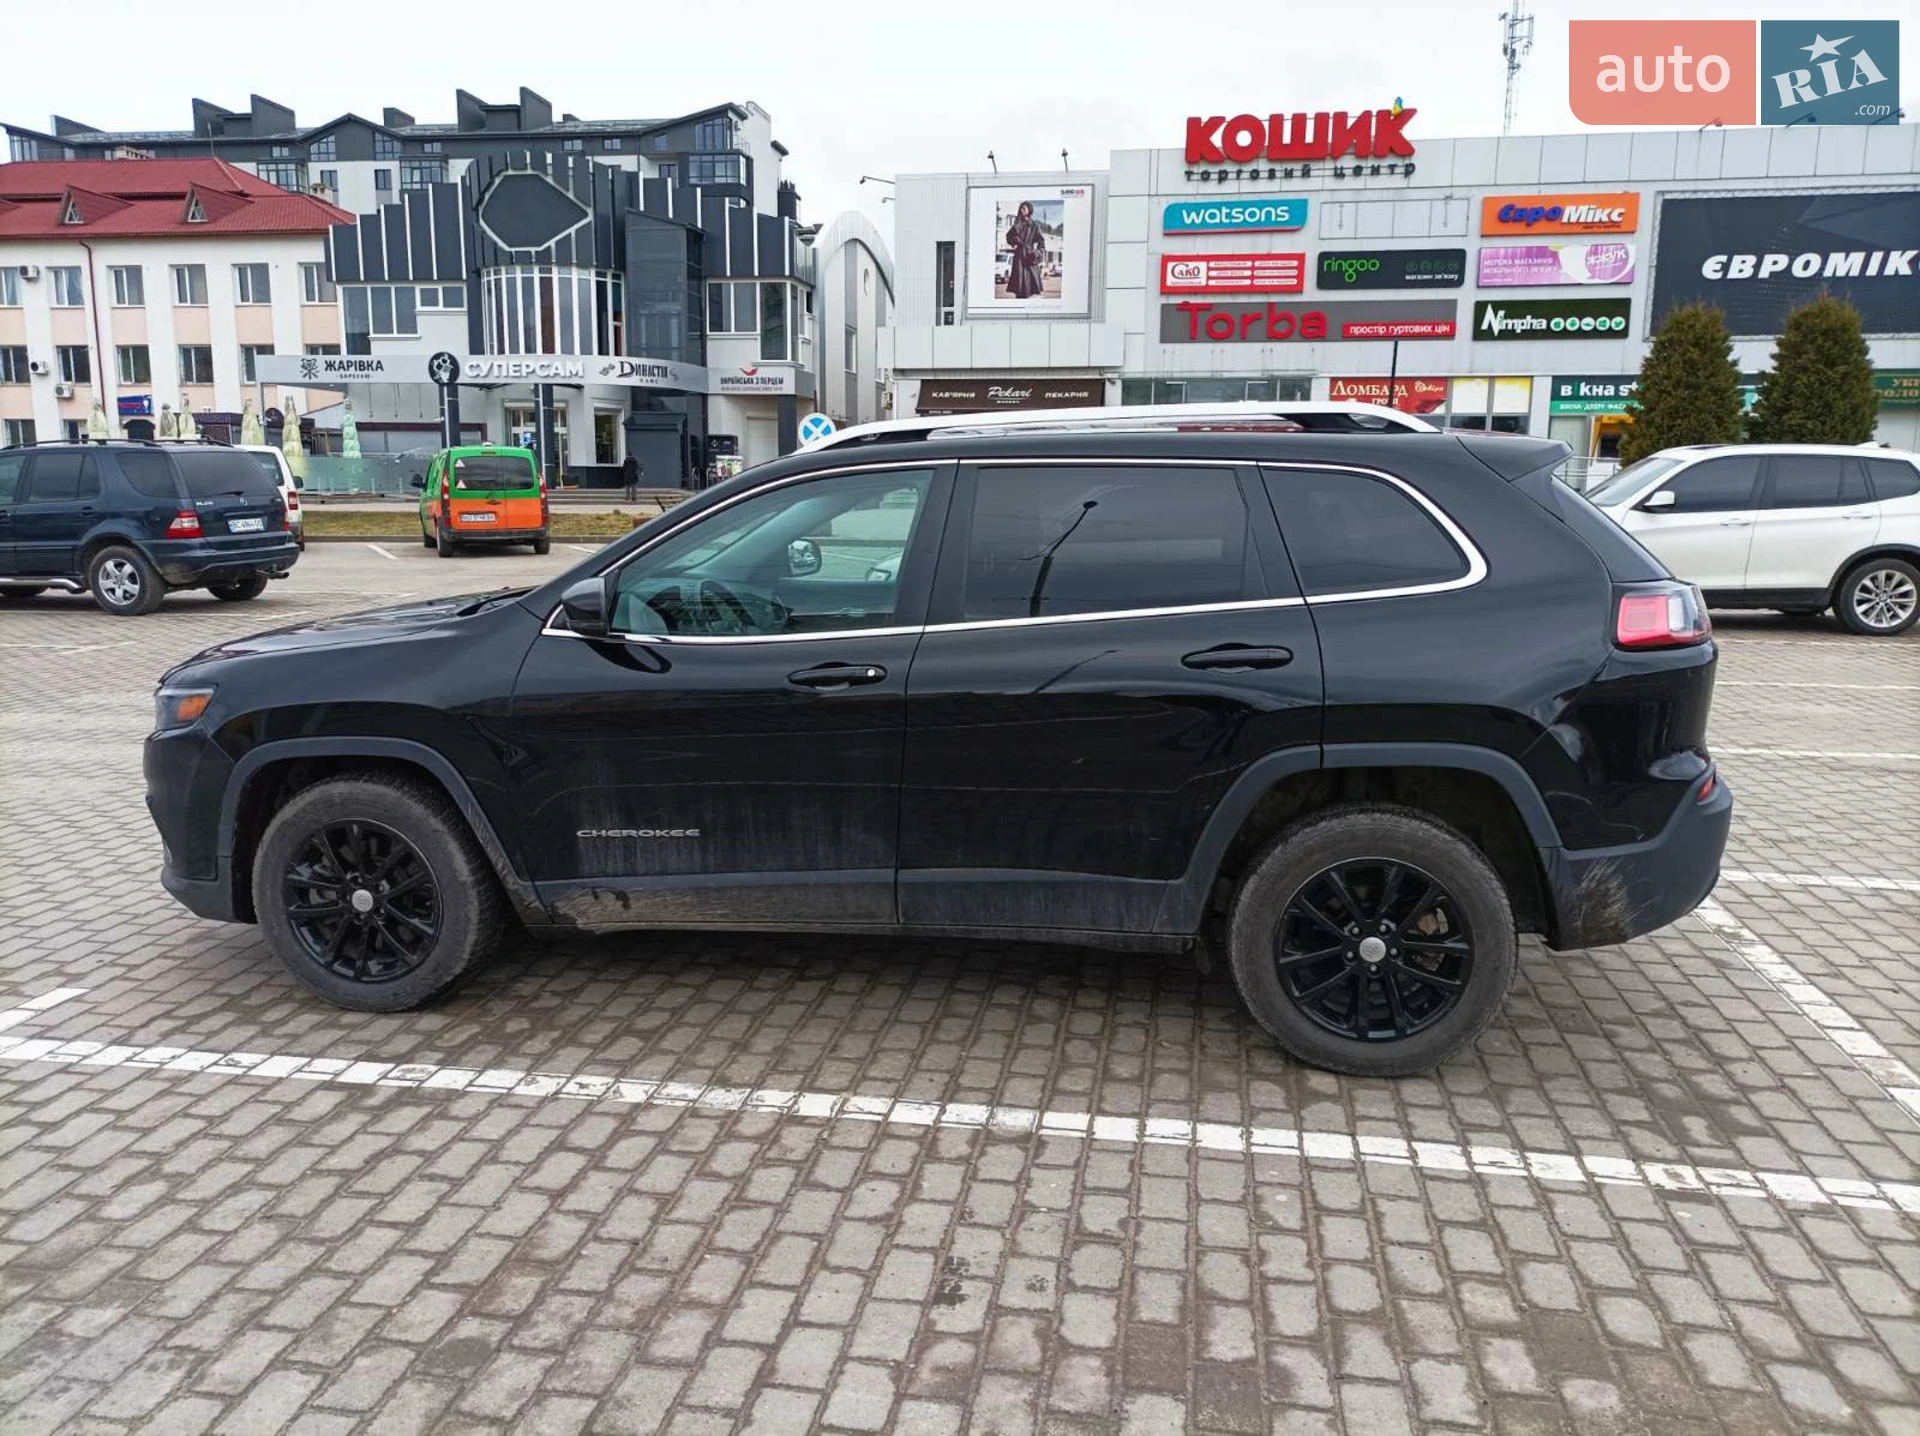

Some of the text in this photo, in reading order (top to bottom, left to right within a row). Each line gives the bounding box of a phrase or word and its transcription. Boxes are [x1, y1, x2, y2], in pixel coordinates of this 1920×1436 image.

[1185, 108, 1418, 164] КОШИК
[1185, 162, 1416, 185] торговий центр
[1182, 205, 1290, 225] watsons
[1323, 257, 1380, 283] ringoo
[1701, 249, 1920, 280] ЄВРОМІК
[1176, 301, 1328, 340] Torba
[1350, 322, 1450, 335] простір гуртових цін
[1481, 303, 1547, 337] Nimpha
[324, 359, 384, 372] ЖАРІВКА
[463, 360, 585, 379] СУПЕРСАМ
[1044, 391, 1089, 399] ПЕКАРНЯ
[576, 828, 701, 838] CHEROKEE
